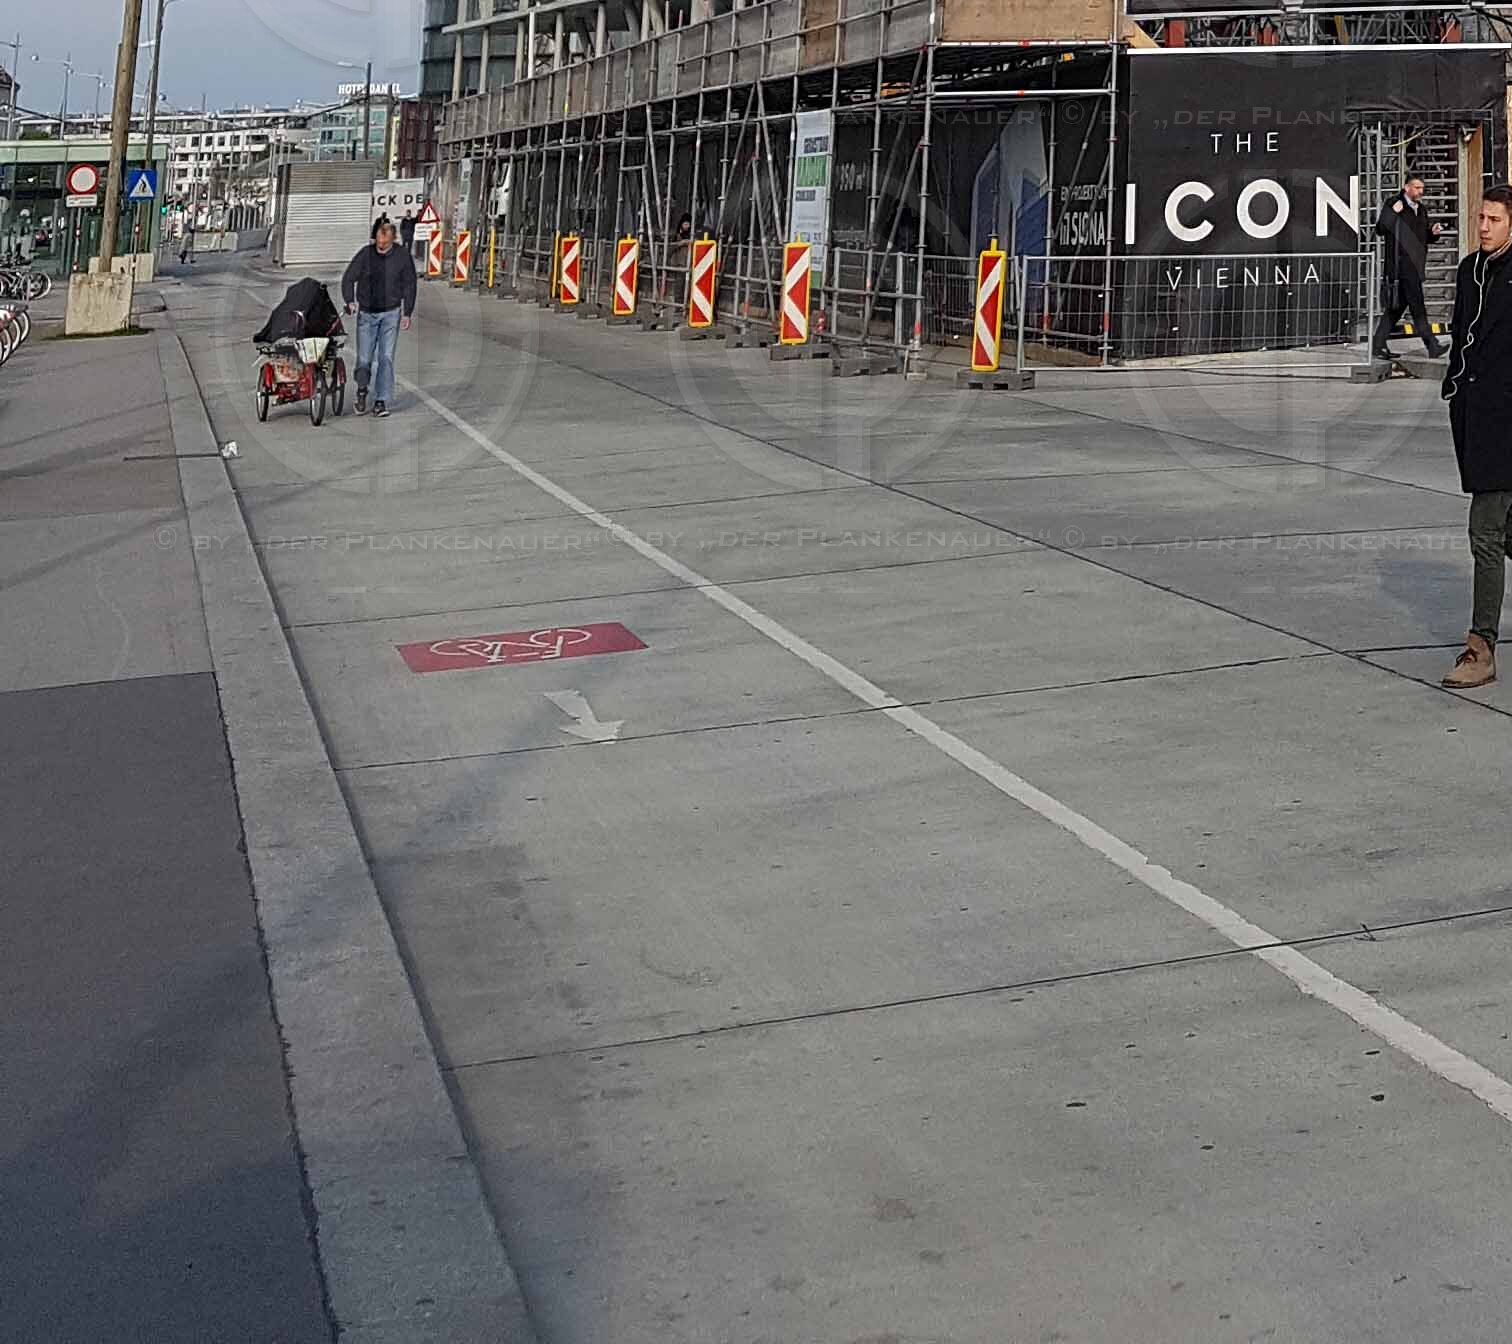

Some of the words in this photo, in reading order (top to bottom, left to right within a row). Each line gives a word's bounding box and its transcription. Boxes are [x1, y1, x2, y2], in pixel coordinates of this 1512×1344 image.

[1211, 132, 1280, 154] THE
[1125, 175, 1359, 245] ICON
[1166, 263, 1320, 291] VIENNA
